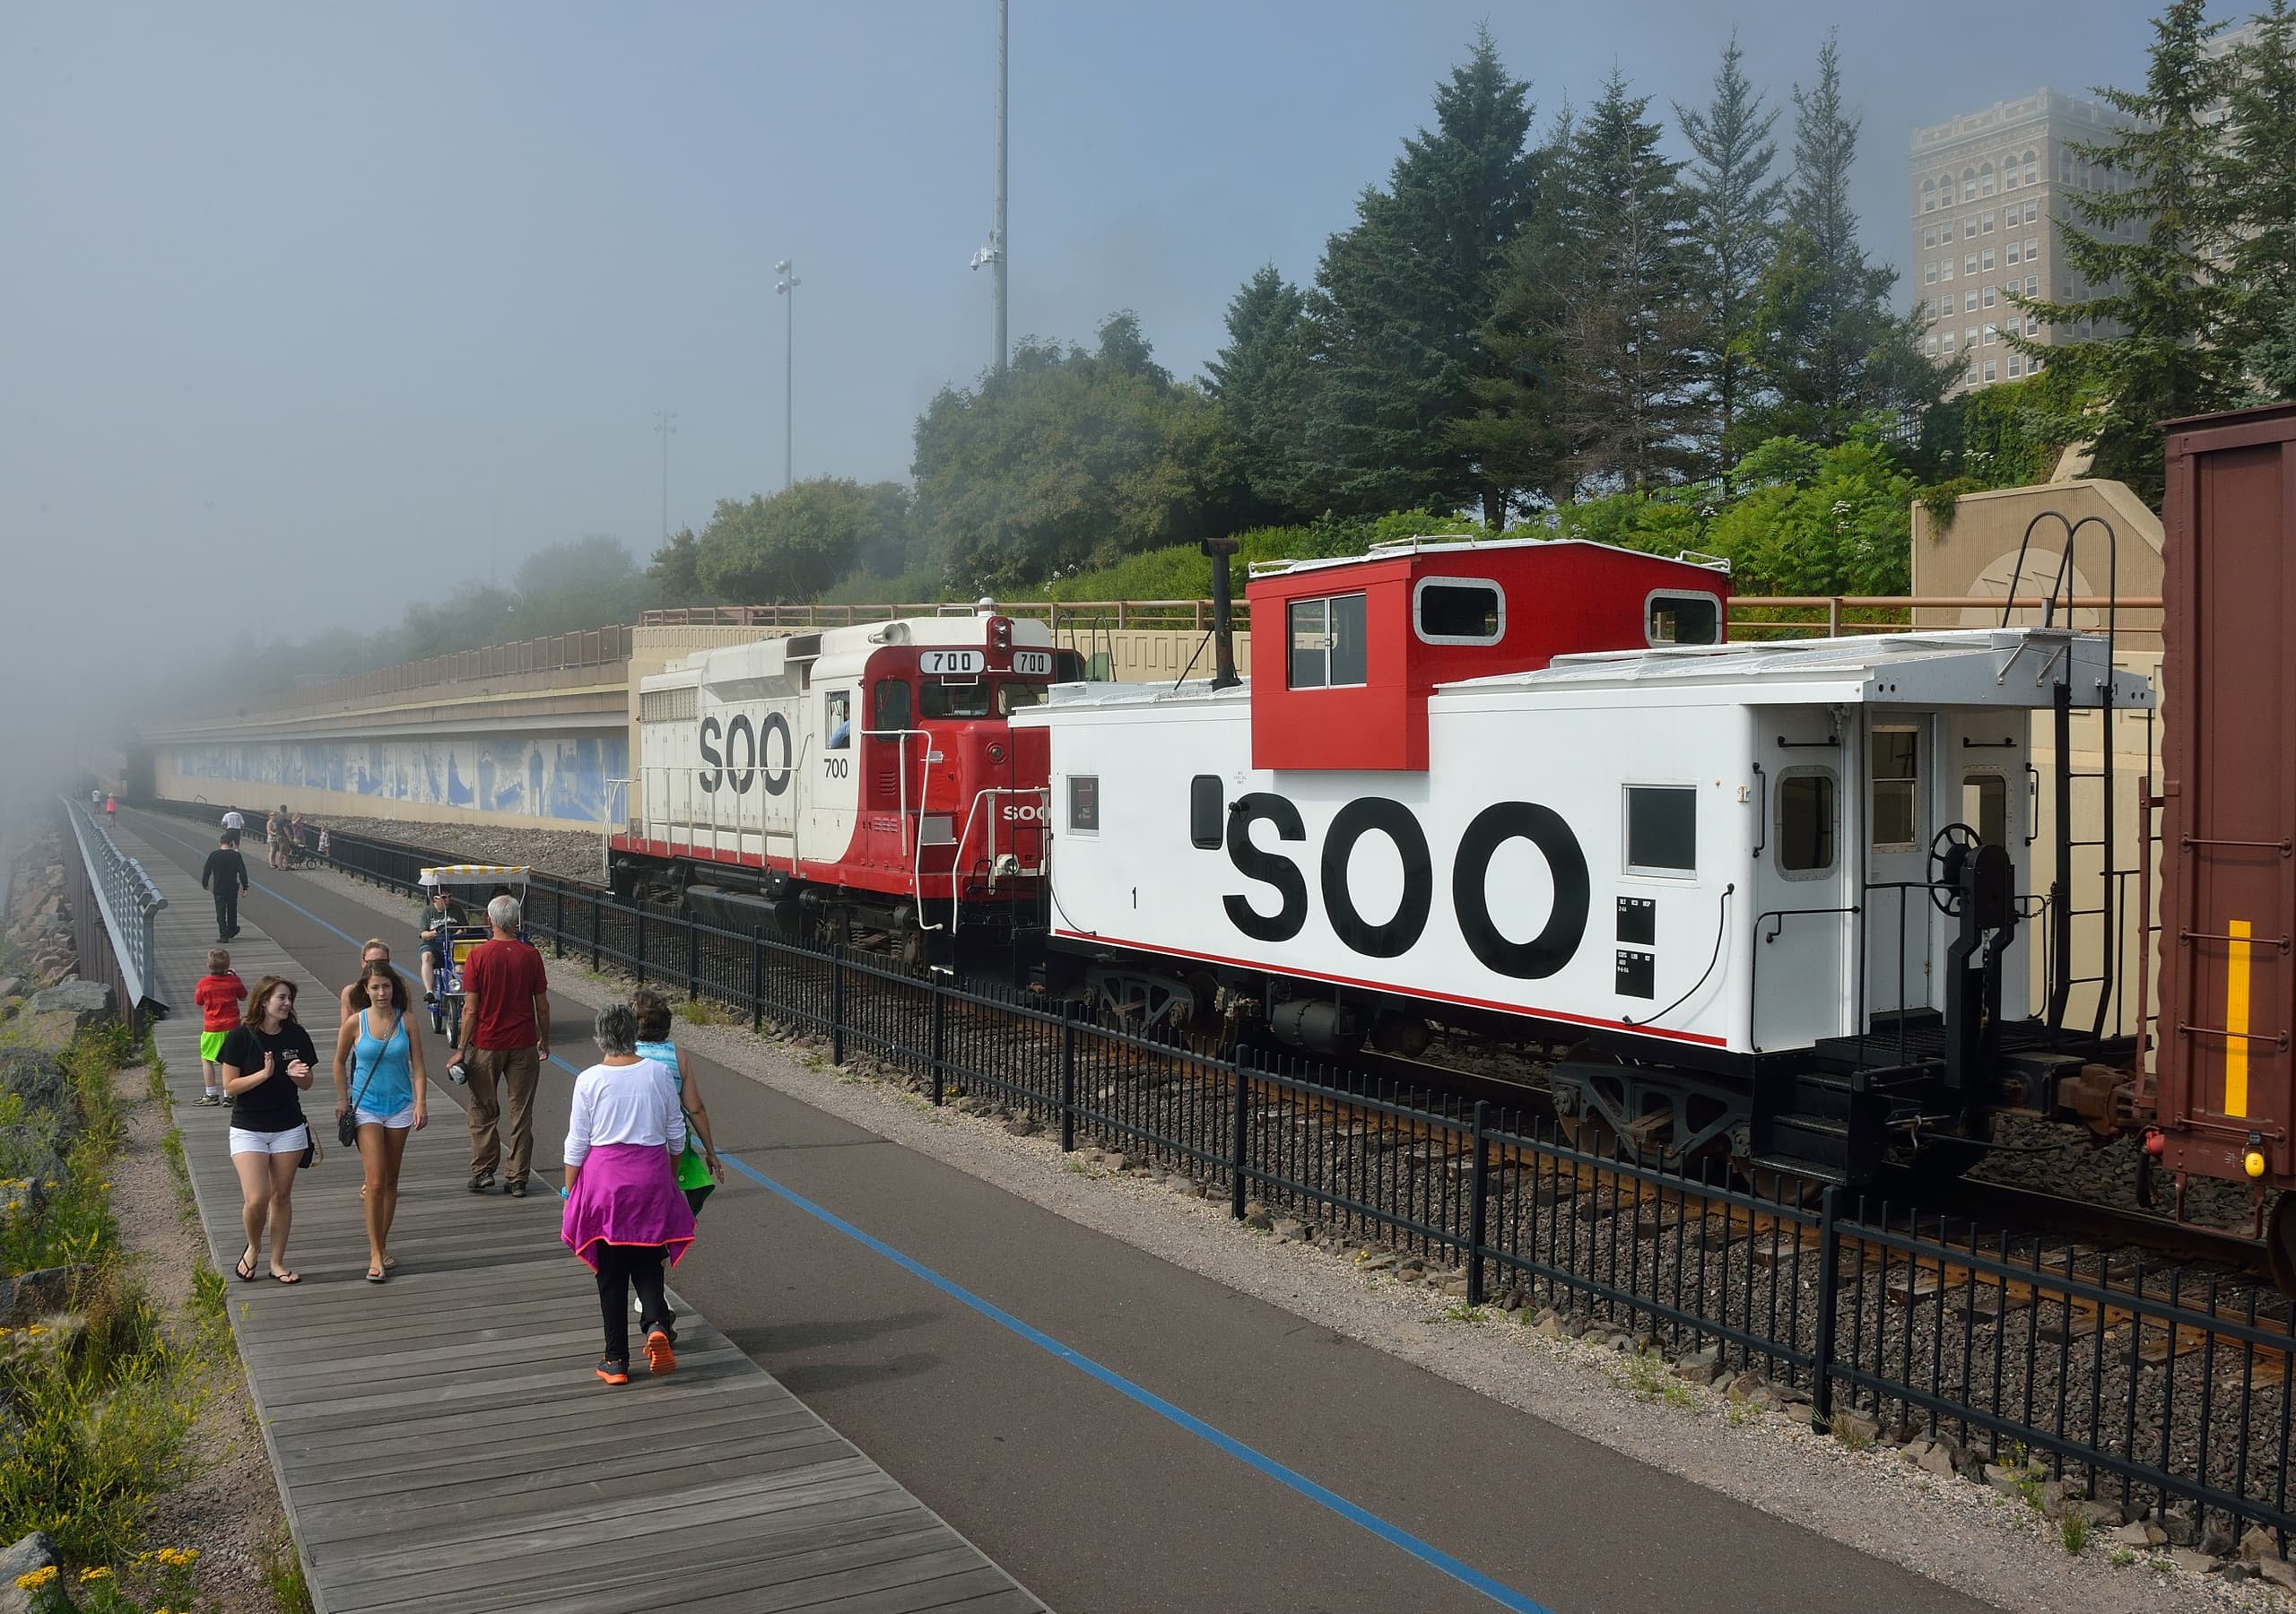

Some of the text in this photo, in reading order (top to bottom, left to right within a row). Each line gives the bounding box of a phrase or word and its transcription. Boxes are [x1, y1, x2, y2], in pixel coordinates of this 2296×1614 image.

[934, 653, 971, 672] 700
[1022, 654, 1044, 672] 700
[699, 711, 792, 796] SOO
[823, 758, 848, 779] 700
[1222, 792, 1591, 980] SOO
[1132, 886, 1137, 909] 1
